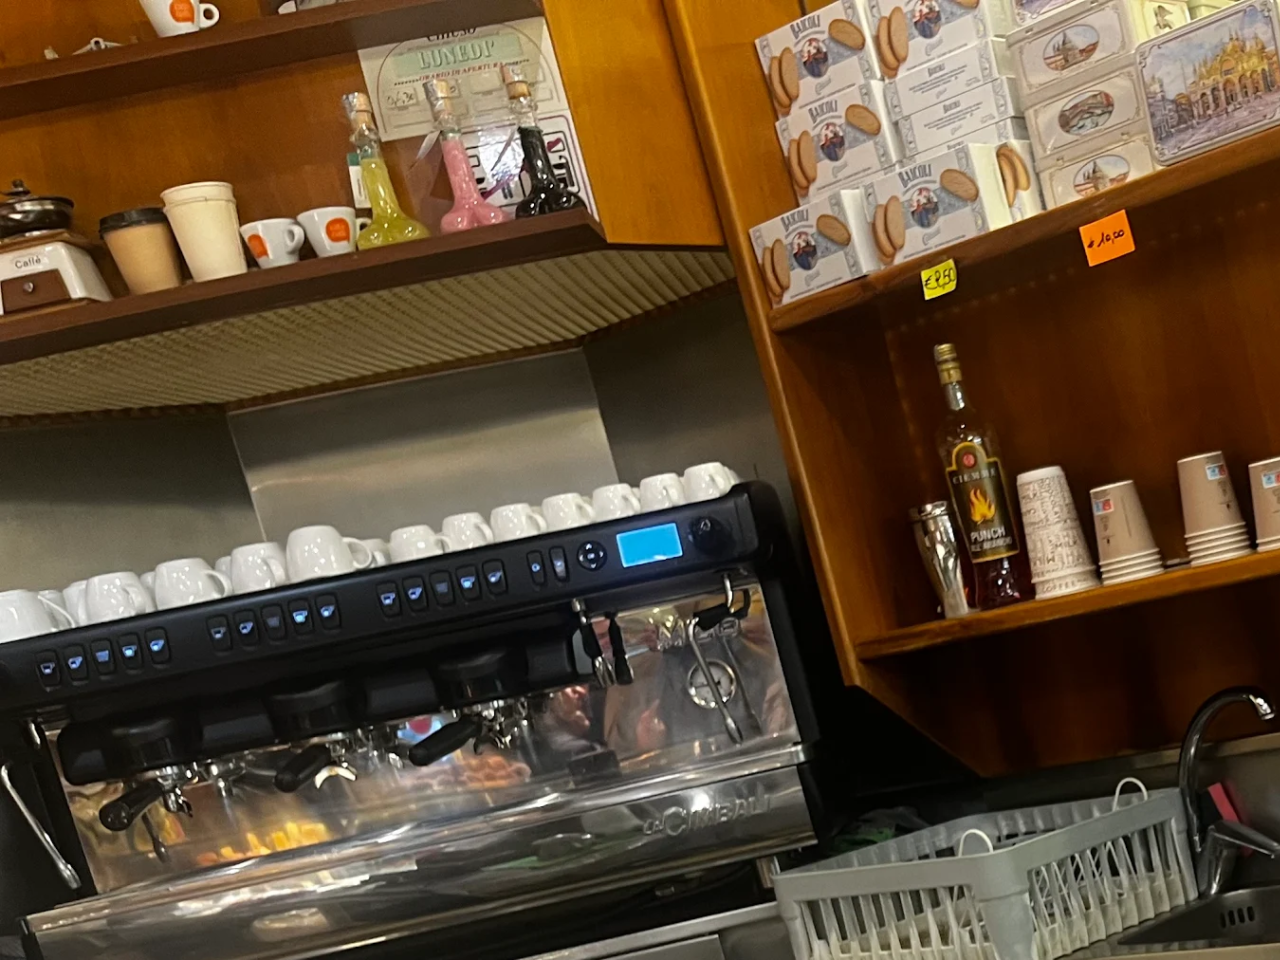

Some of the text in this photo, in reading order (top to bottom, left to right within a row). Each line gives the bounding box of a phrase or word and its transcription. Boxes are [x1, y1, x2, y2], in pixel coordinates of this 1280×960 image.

[1096, 229, 1125, 248] 10,00
[14, 255, 42, 269] Caffè
[970, 525, 1006, 543] PUNCH
